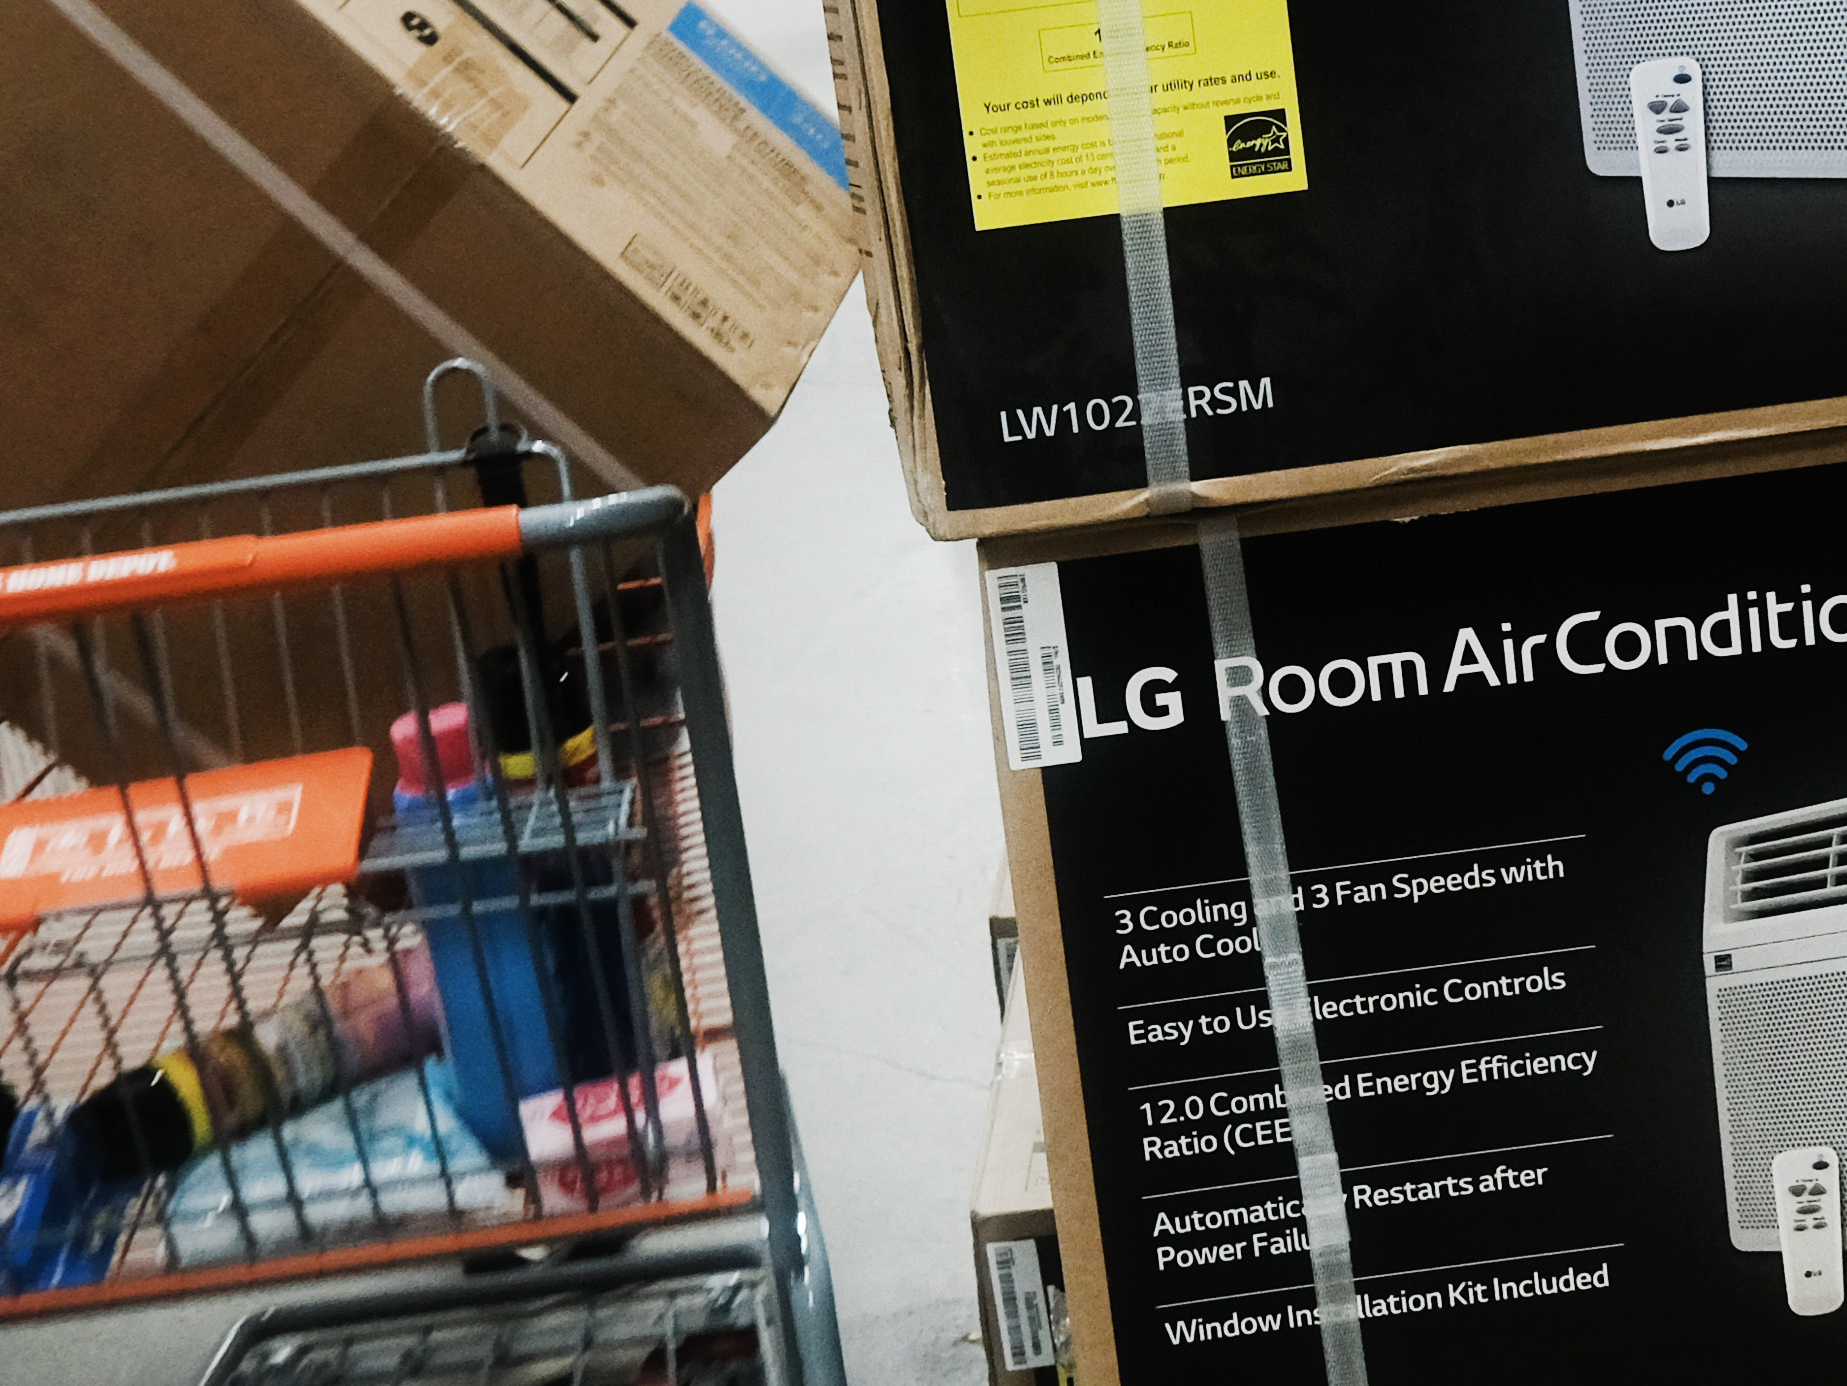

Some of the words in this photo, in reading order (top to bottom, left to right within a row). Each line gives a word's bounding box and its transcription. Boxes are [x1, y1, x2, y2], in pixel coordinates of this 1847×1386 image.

[1161, 78, 1195, 94] utility
[1198, 75, 1227, 88] rates
[1230, 70, 1252, 84] and
[1255, 69, 1281, 81] use.
[1233, 164, 1266, 176] ENERGY
[1267, 160, 1290, 172] STAR
[1000, 377, 1274, 443] LW102RSM
[1075, 666, 1185, 739] LG
[1213, 651, 1429, 722] Room
[1115, 909, 1135, 934] 3
[1140, 898, 1248, 931] Cooling
[1311, 884, 1331, 909] 3
[1336, 879, 1387, 906] Fan
[1392, 862, 1497, 904] Speeds
[1501, 854, 1565, 885] with
[1119, 941, 1190, 968] Auto
[1195, 927, 1261, 957] Cool
[1128, 1017, 1193, 1046] Easy
[1198, 1010, 1231, 1035] to
[1236, 1007, 1273, 1031] Us
[1313, 983, 1438, 1021] lectronic
[1443, 966, 1566, 1003] Controls
[1140, 1095, 1204, 1126] 12.0
[1209, 1075, 1351, 1117] Comed
[1357, 1064, 1454, 1097] Energy
[1461, 1049, 1598, 1084] Efficiency
[1165, 1309, 1282, 1345] Window
[1288, 1280, 1443, 1327] Insllation
[1448, 1273, 1488, 1305] Kit
[1493, 1262, 1610, 1300] Included
